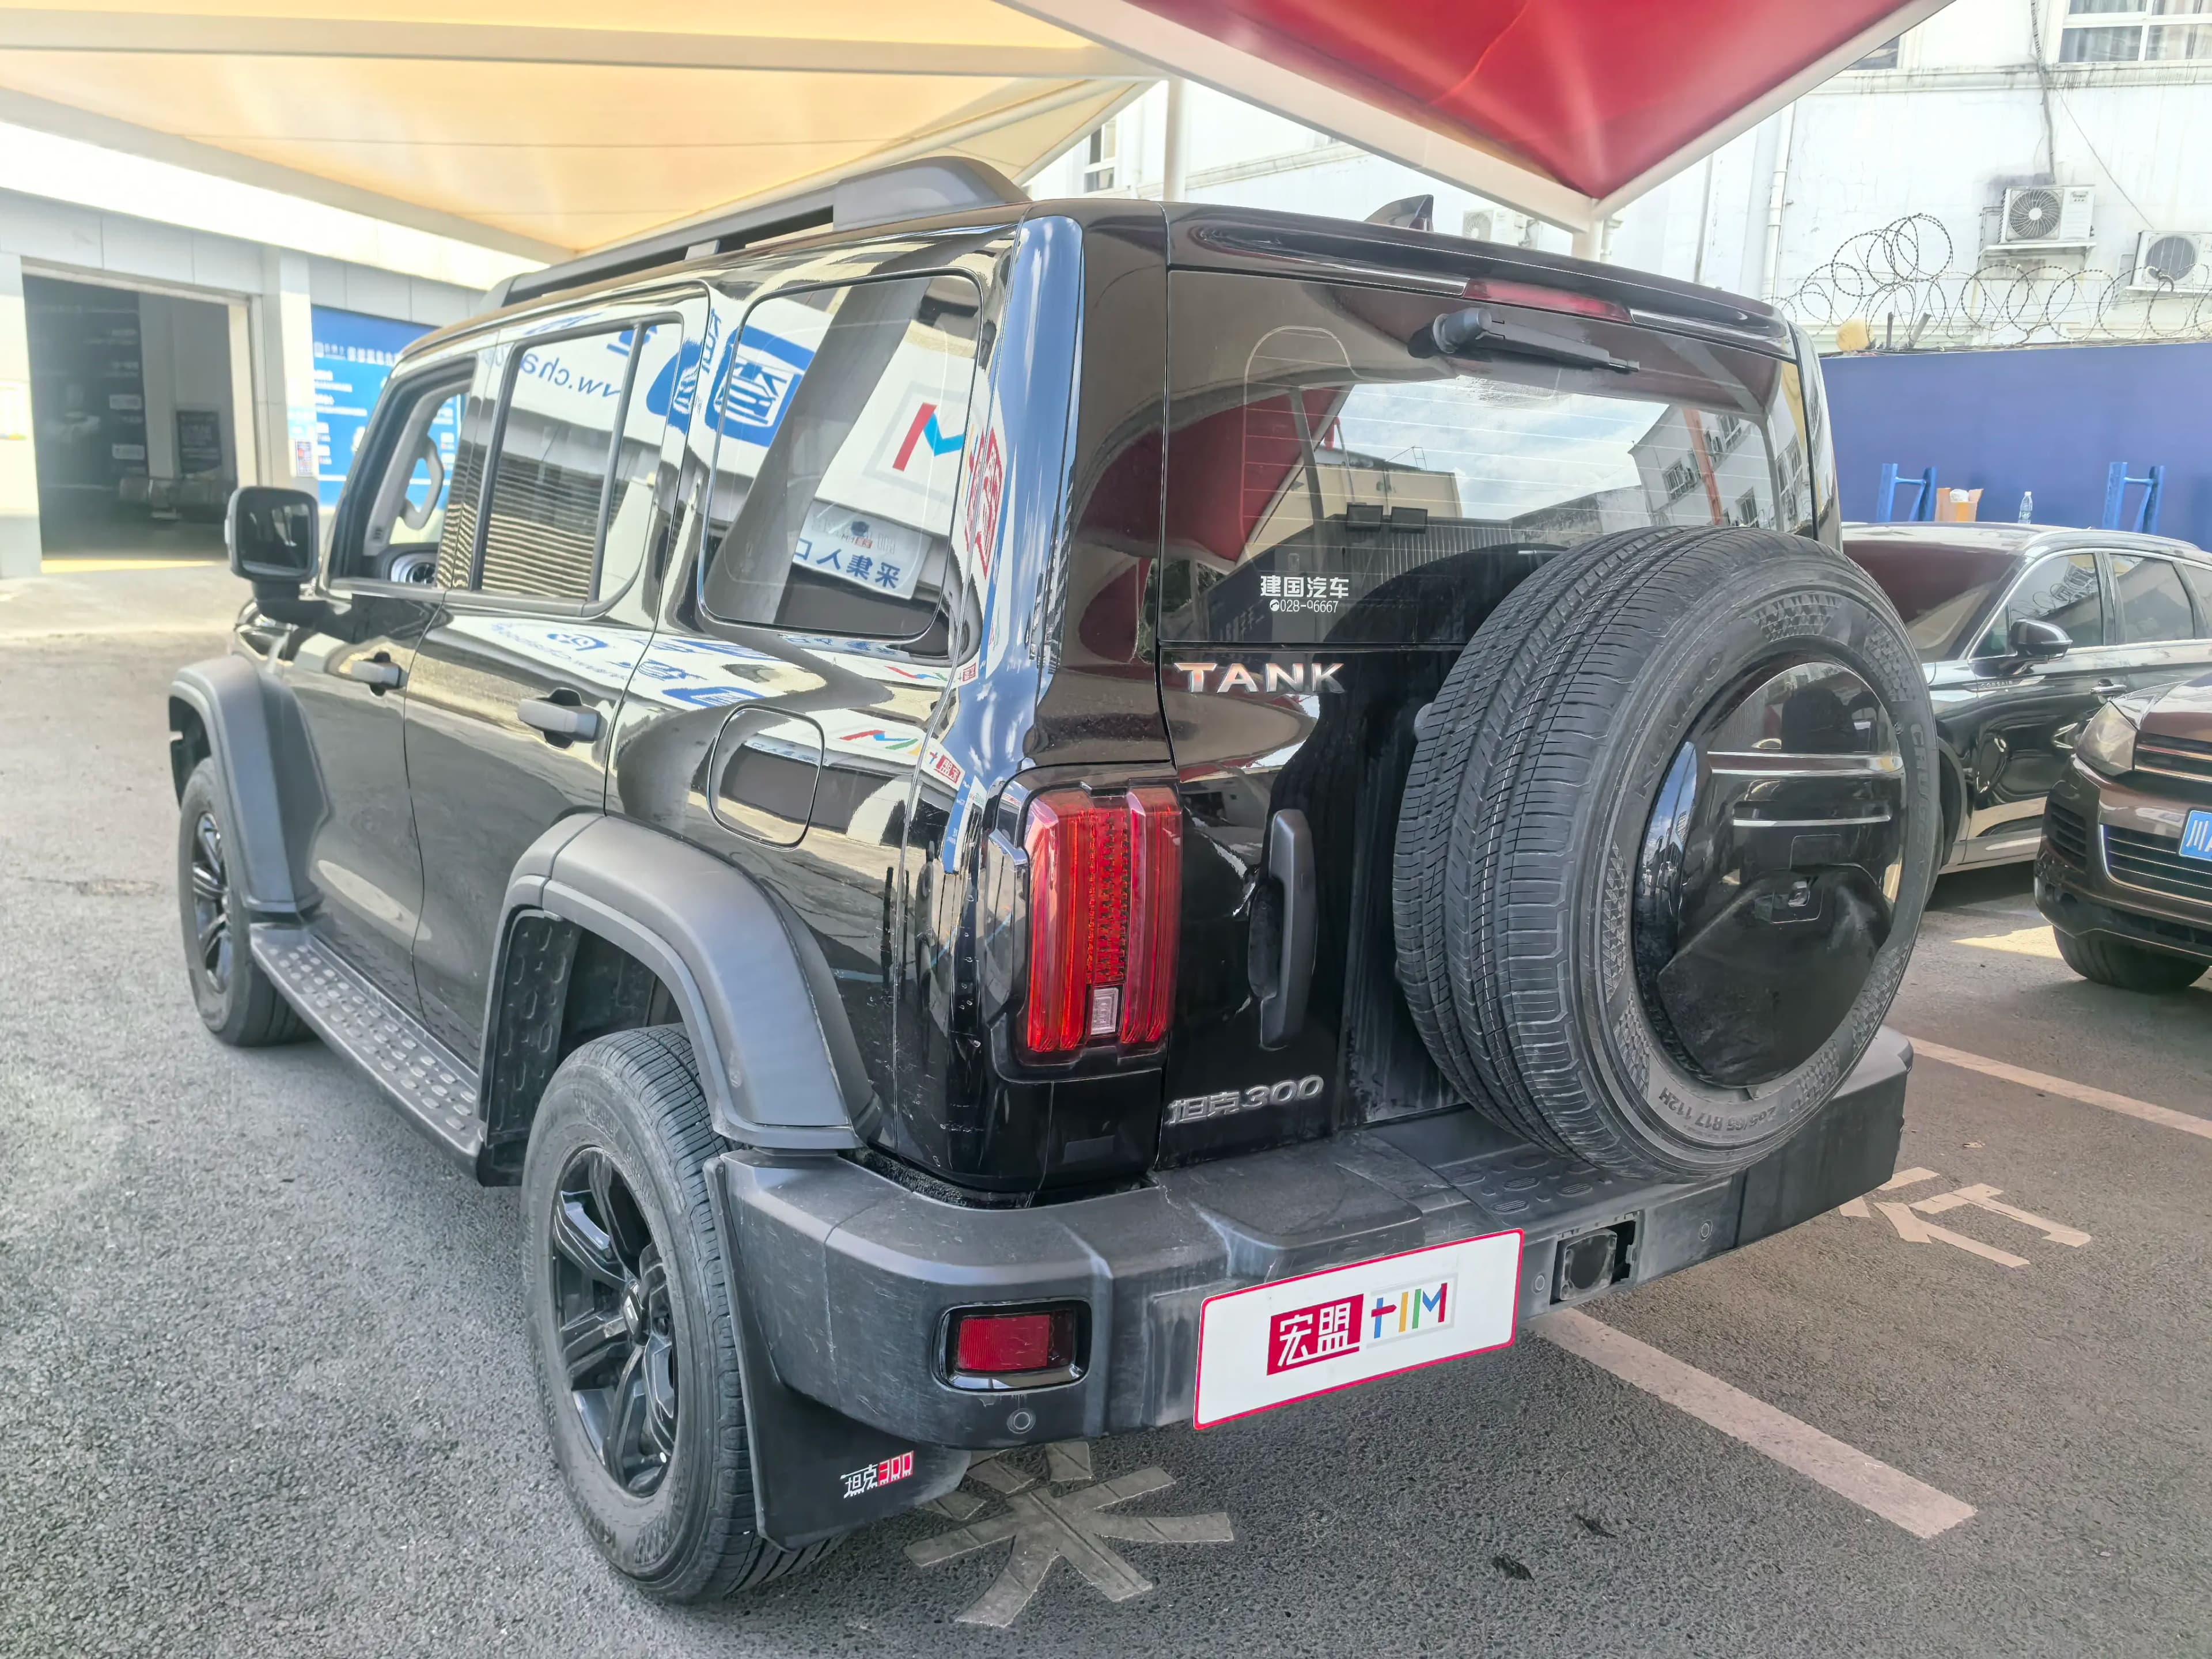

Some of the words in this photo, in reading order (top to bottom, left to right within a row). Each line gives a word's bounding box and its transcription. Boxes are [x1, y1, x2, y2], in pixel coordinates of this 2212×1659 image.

[1260, 575, 1349, 599] 建国汽车
[1174, 662, 1346, 694] TANK
[1165, 1074, 1324, 1126] 坦克300
[1658, 1087, 1692, 1120] 112H
[1694, 1112, 1724, 1131] R17
[1277, 1301, 1360, 1368] 宏盟
[840, 1450, 915, 1499] 坦克300
